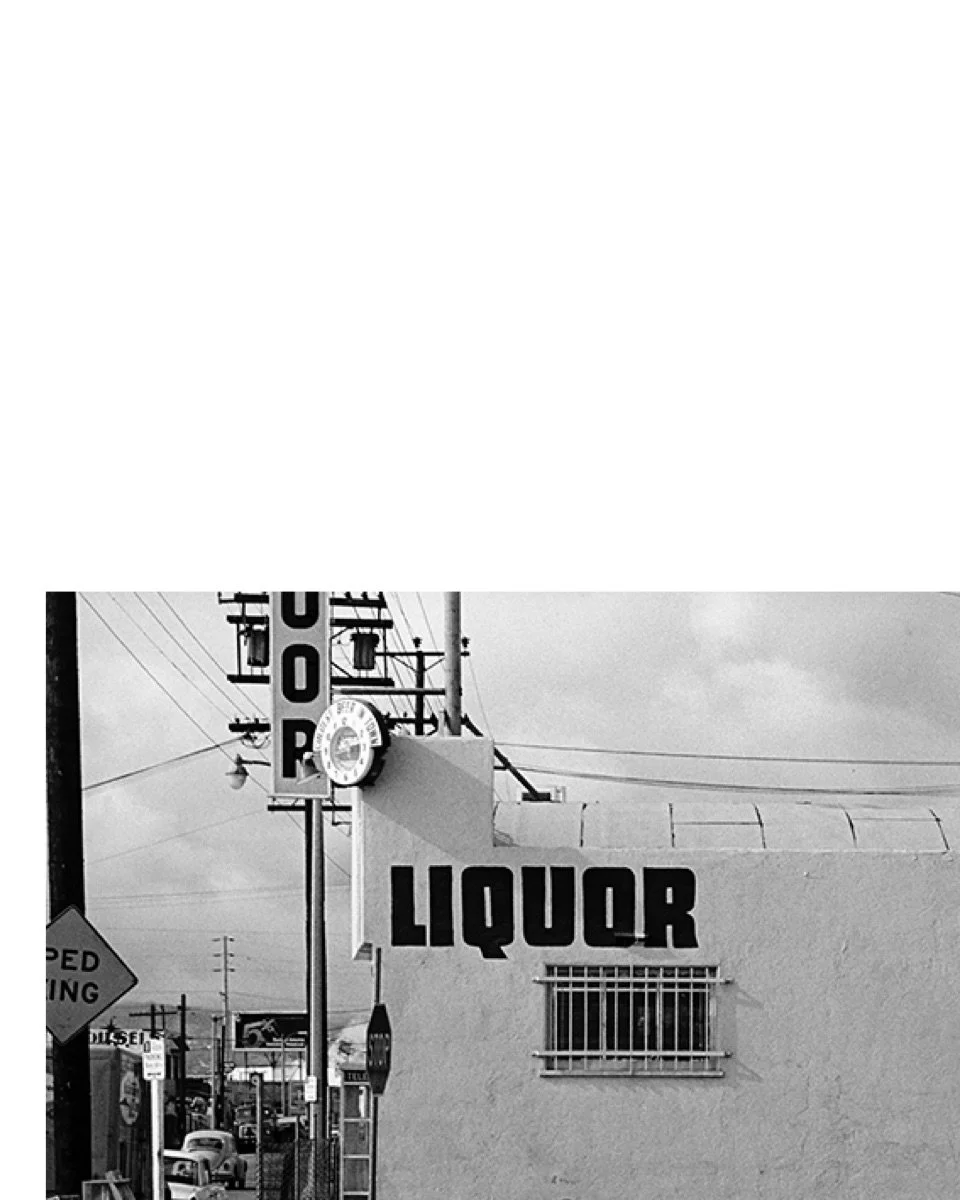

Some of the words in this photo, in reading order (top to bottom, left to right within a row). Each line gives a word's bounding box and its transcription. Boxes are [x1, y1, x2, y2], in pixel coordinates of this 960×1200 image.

[391, 866, 699, 959] LIQUOR
[46, 947, 99, 972] PED
[46, 979, 99, 1004] ING
